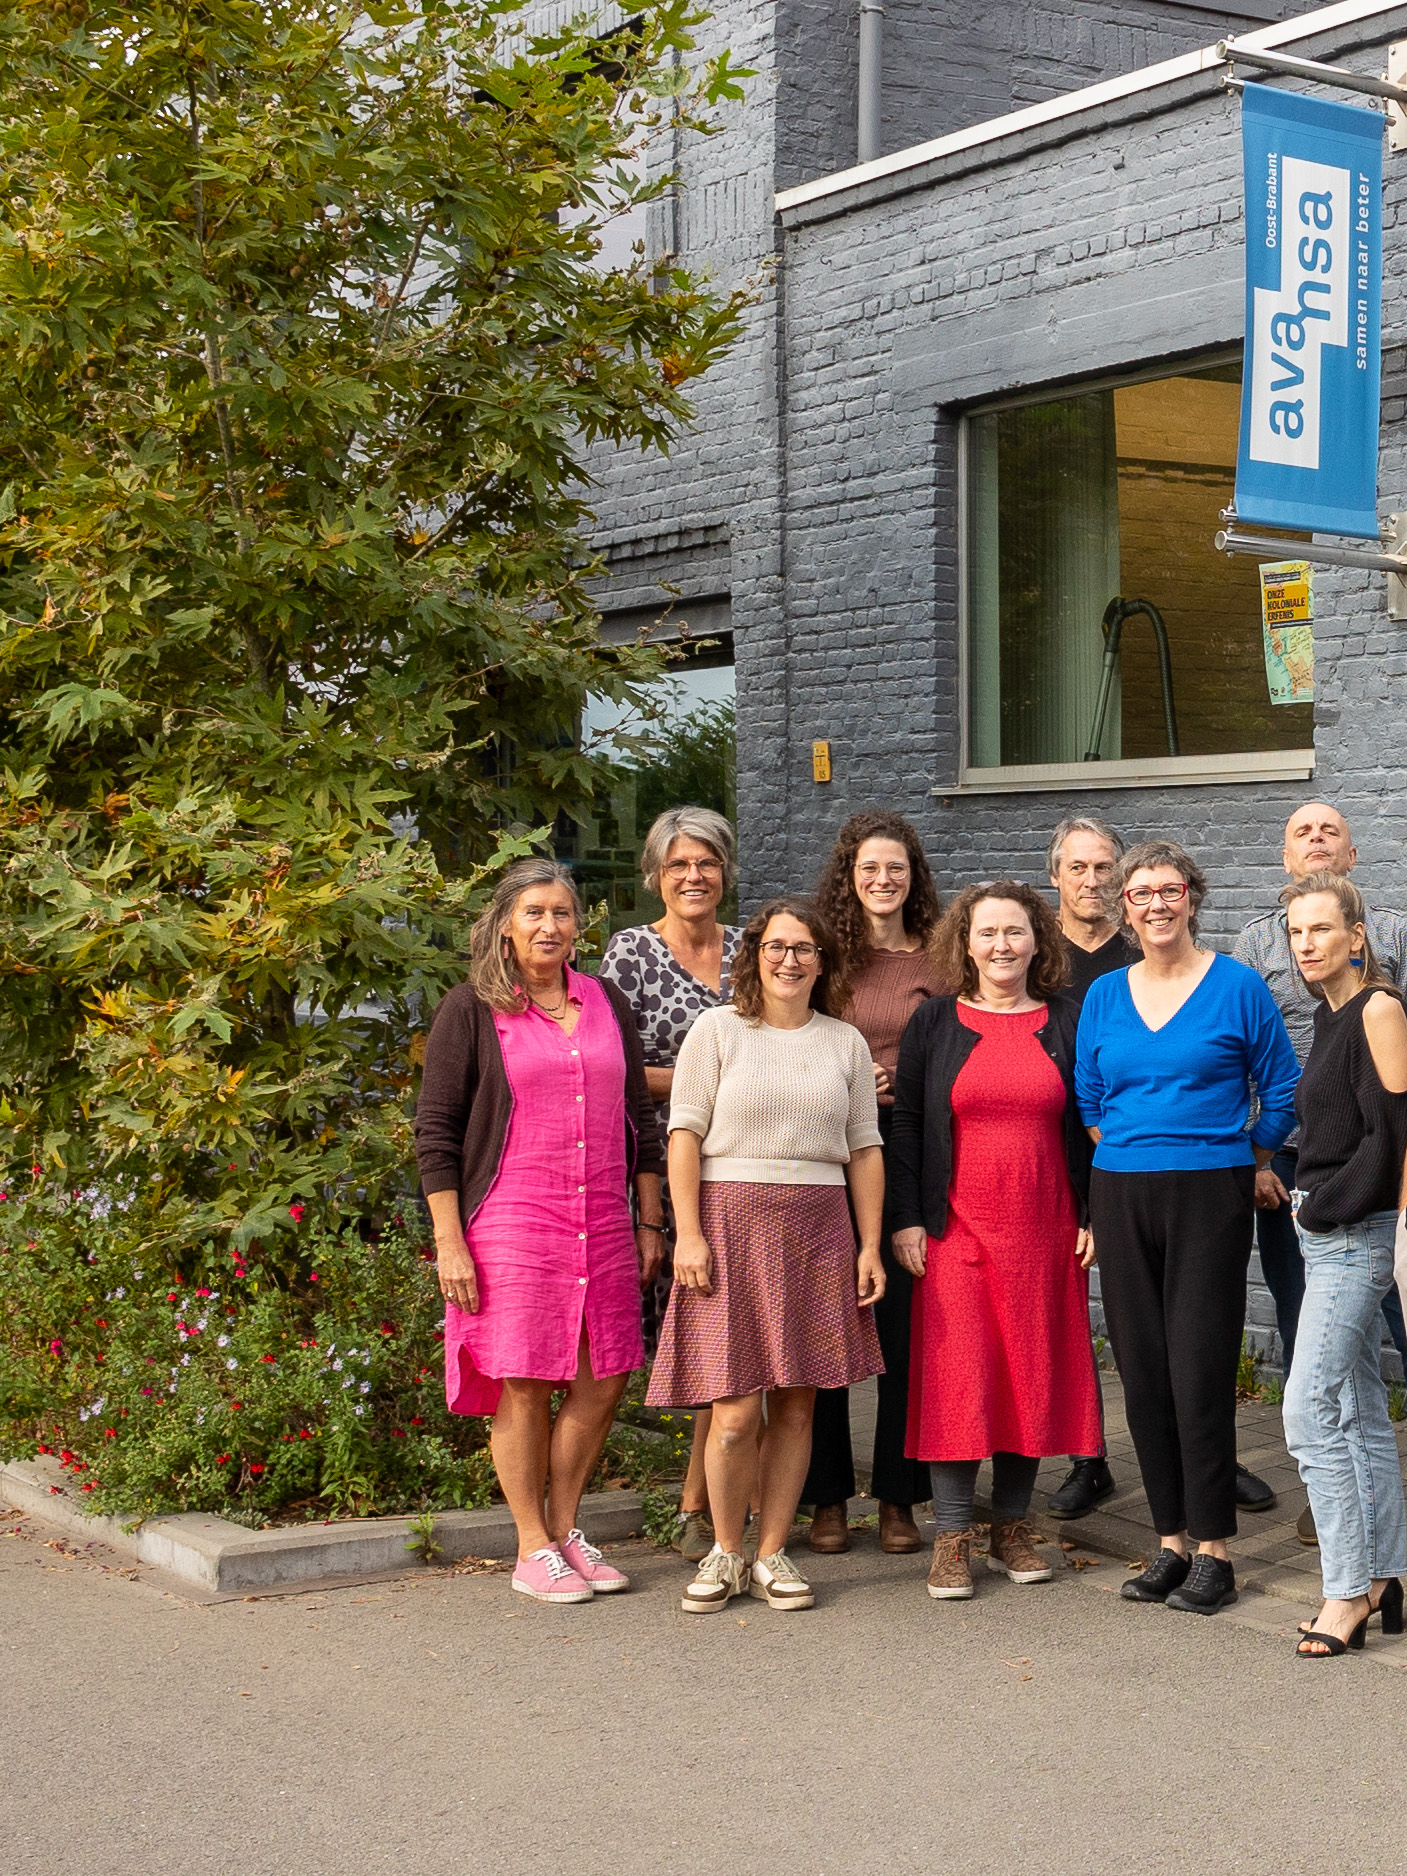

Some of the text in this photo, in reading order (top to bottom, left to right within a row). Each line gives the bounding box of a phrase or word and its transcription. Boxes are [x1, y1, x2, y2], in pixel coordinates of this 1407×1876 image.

[1265, 152, 1279, 249] Oost-Brabant
[1356, 173, 1370, 371] samen naar beter
[1269, 191, 1332, 439] avansa
[1267, 597, 1306, 611] KOLONIALE
